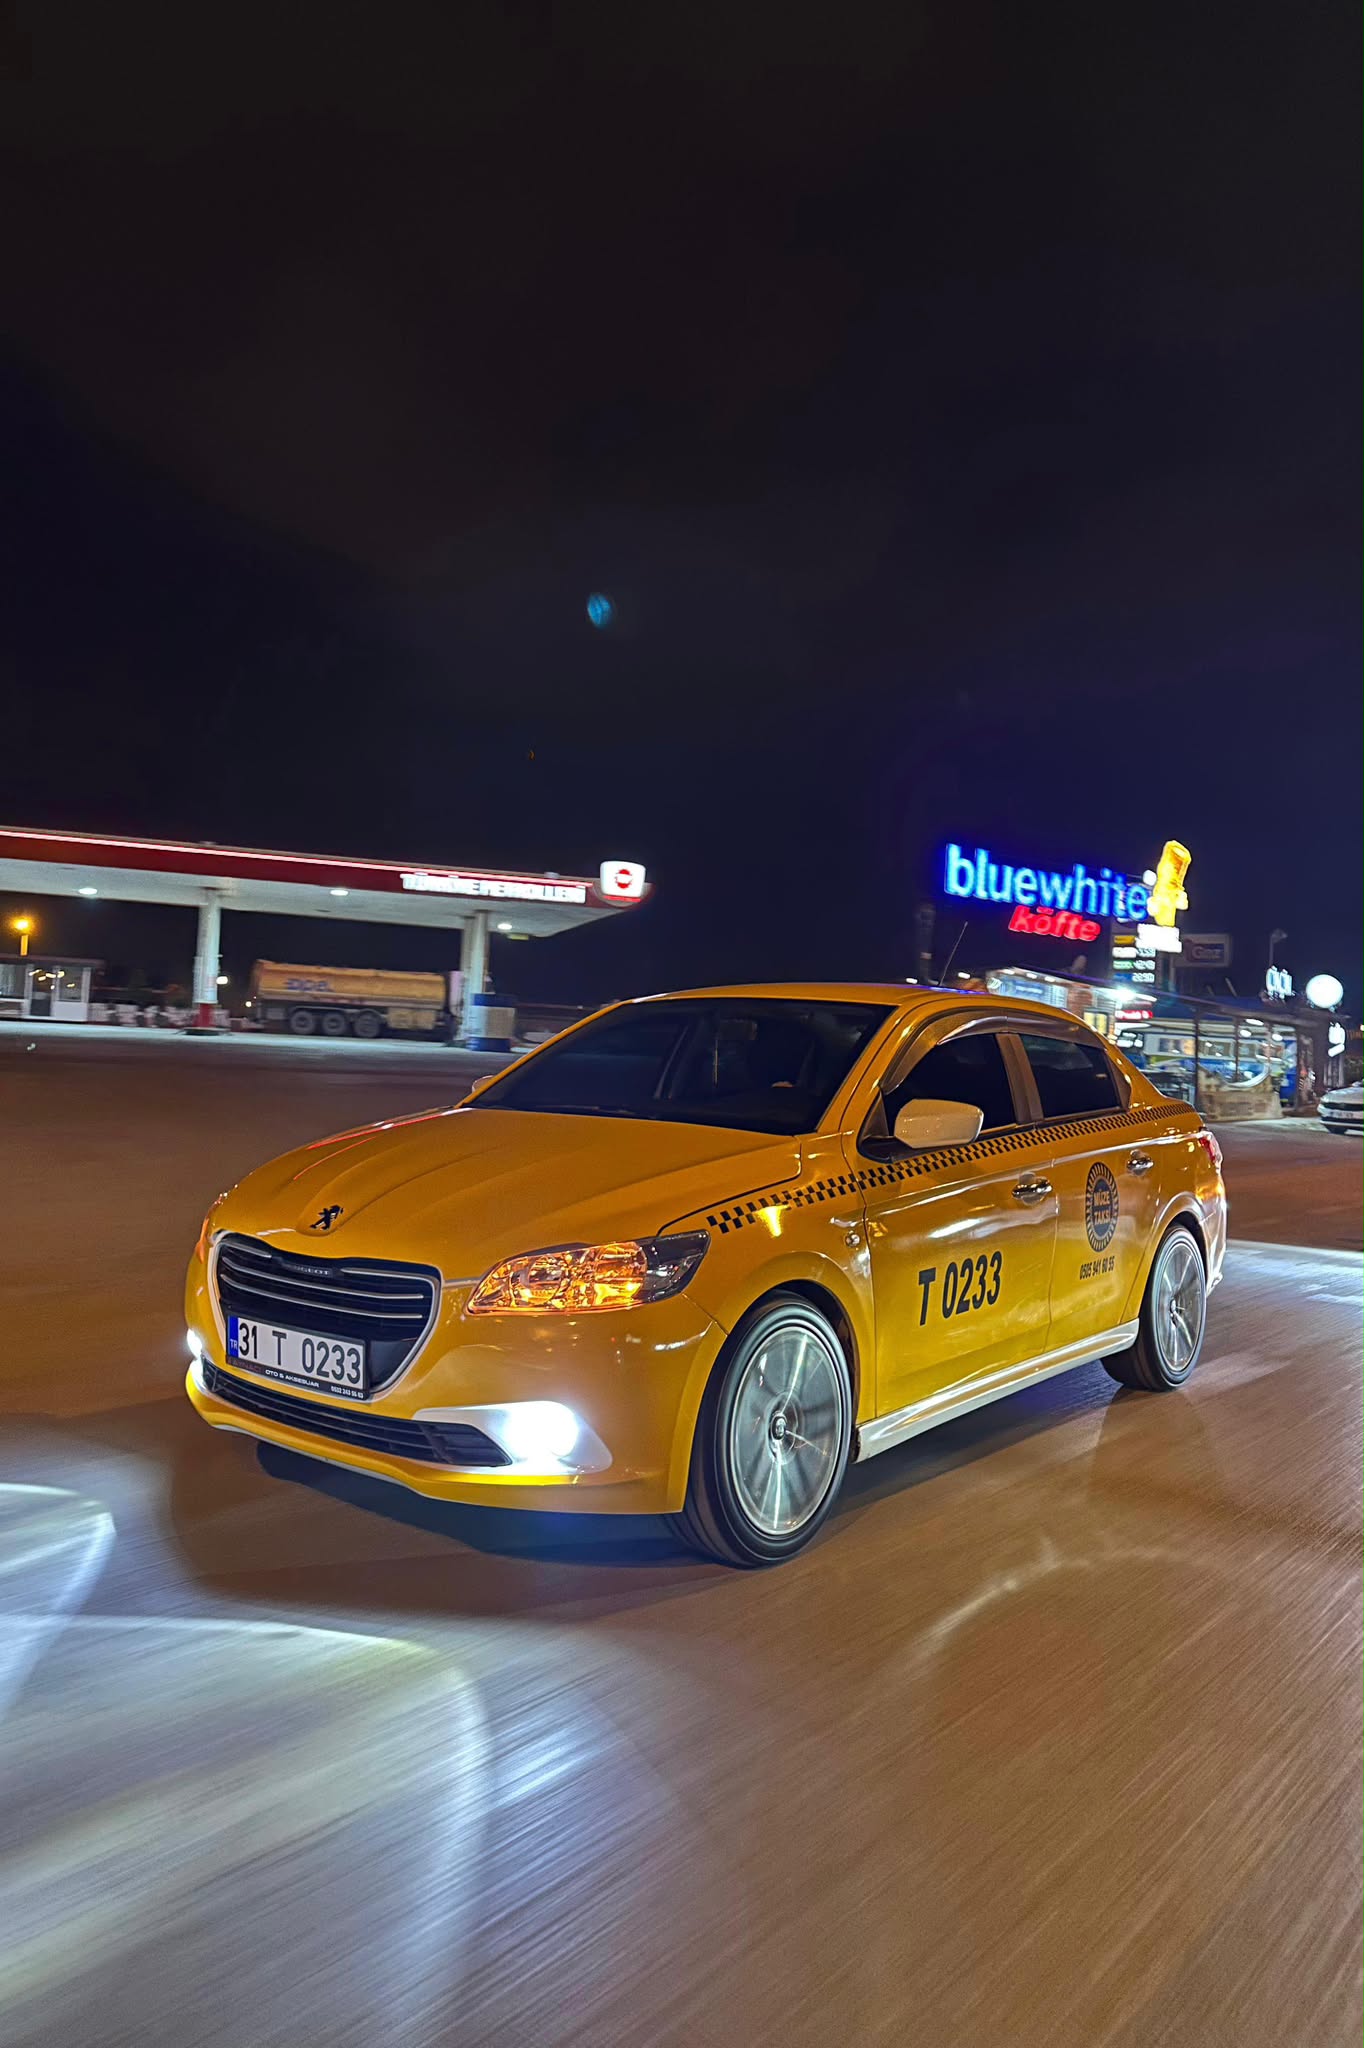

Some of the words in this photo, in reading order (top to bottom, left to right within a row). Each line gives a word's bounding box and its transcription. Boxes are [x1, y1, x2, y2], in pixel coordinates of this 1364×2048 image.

[945, 843, 1149, 921] bluewhite
[1008, 904, 1101, 942] köfte
[918, 1267, 936, 1327] T
[942, 1250, 1002, 1319] 0233
[229, 1338, 238, 1351] TR
[239, 1322, 258, 1359] 31
[272, 1330, 287, 1366] T
[302, 1338, 361, 1385] 0233
[285, 1374, 320, 1388] AKSESUAR
